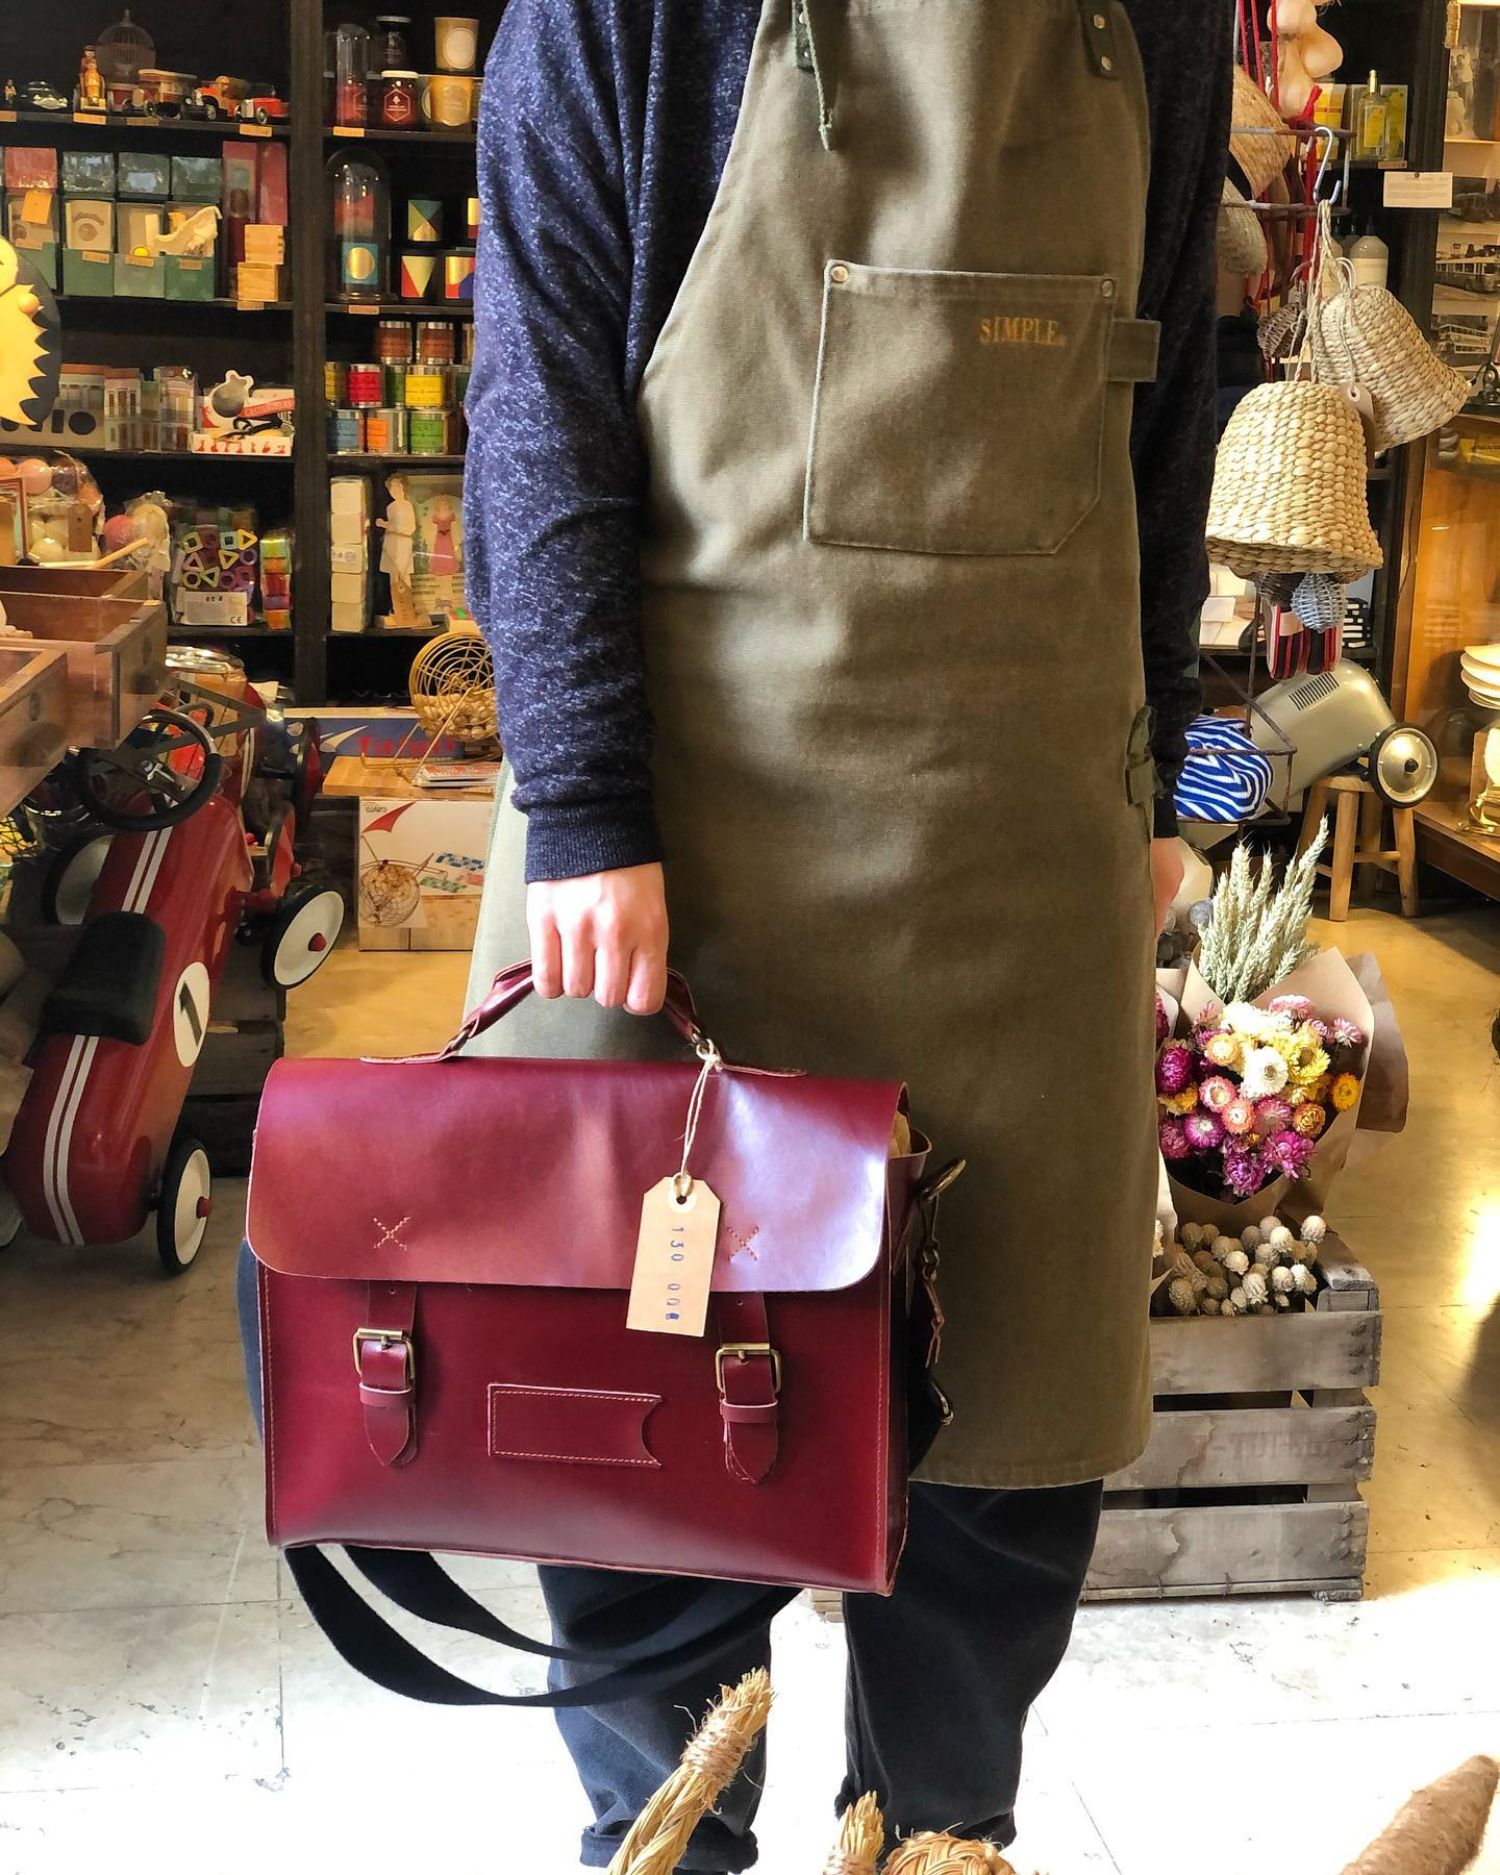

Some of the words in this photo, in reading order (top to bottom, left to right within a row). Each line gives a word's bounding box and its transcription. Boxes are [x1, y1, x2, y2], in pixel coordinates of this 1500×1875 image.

[230, 616, 243, 624] CE
[178, 980, 203, 1047] 1
[670, 1226, 685, 1261] 130
